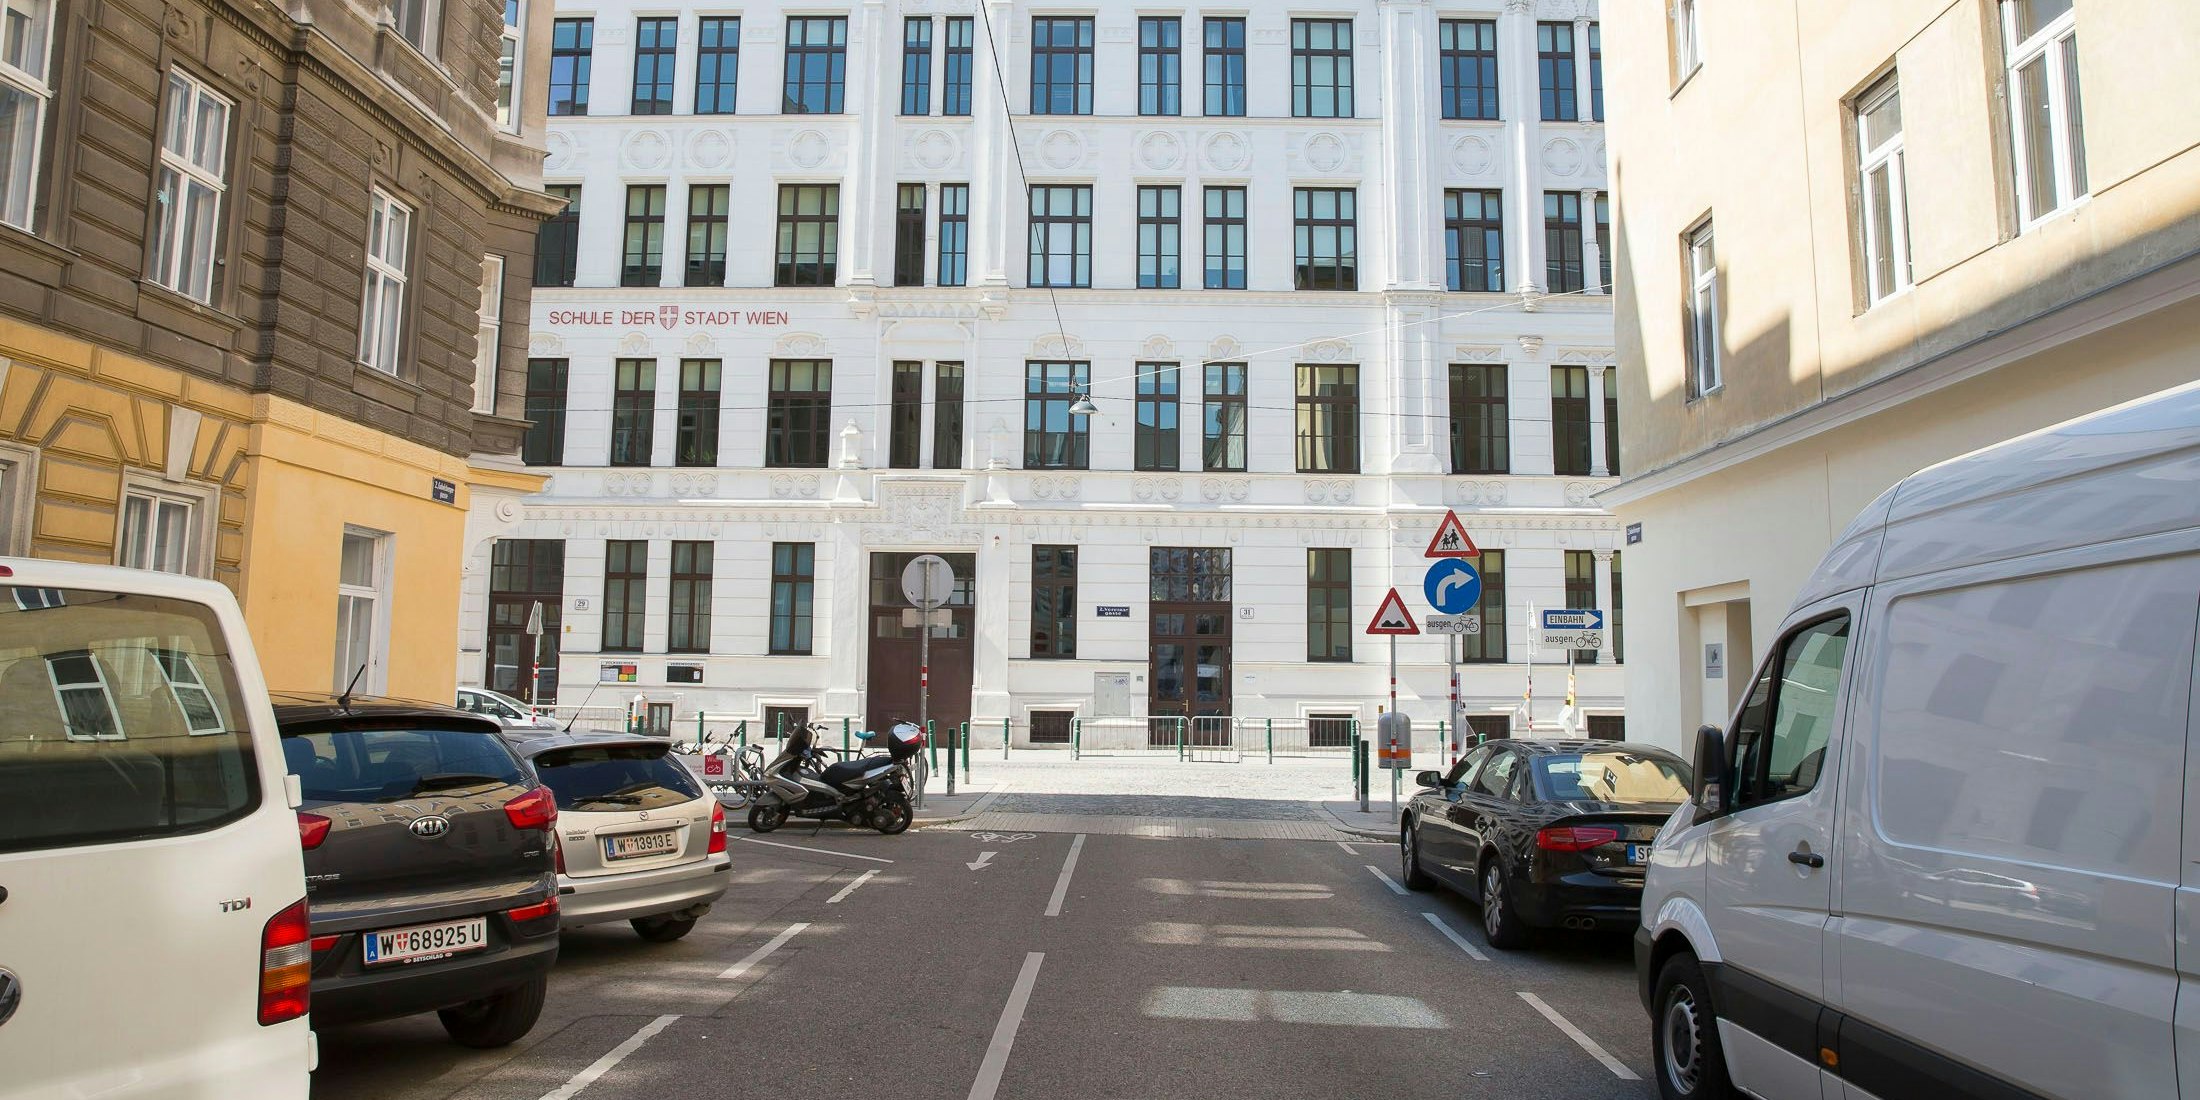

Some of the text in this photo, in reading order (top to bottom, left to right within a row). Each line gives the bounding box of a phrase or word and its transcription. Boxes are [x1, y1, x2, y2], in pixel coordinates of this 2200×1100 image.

[549, 310, 789, 325] SCHULE DER STADT WIEN
[1427, 620, 1453, 630] ausgen.
[1550, 615, 1584, 624] EINBAHN
[1545, 635, 1575, 644] ausgen.
[417, 820, 444, 834] KIA
[617, 834, 673, 853] W 13913 E
[219, 896, 251, 912] TDI
[381, 923, 481, 955] W 68925 U
